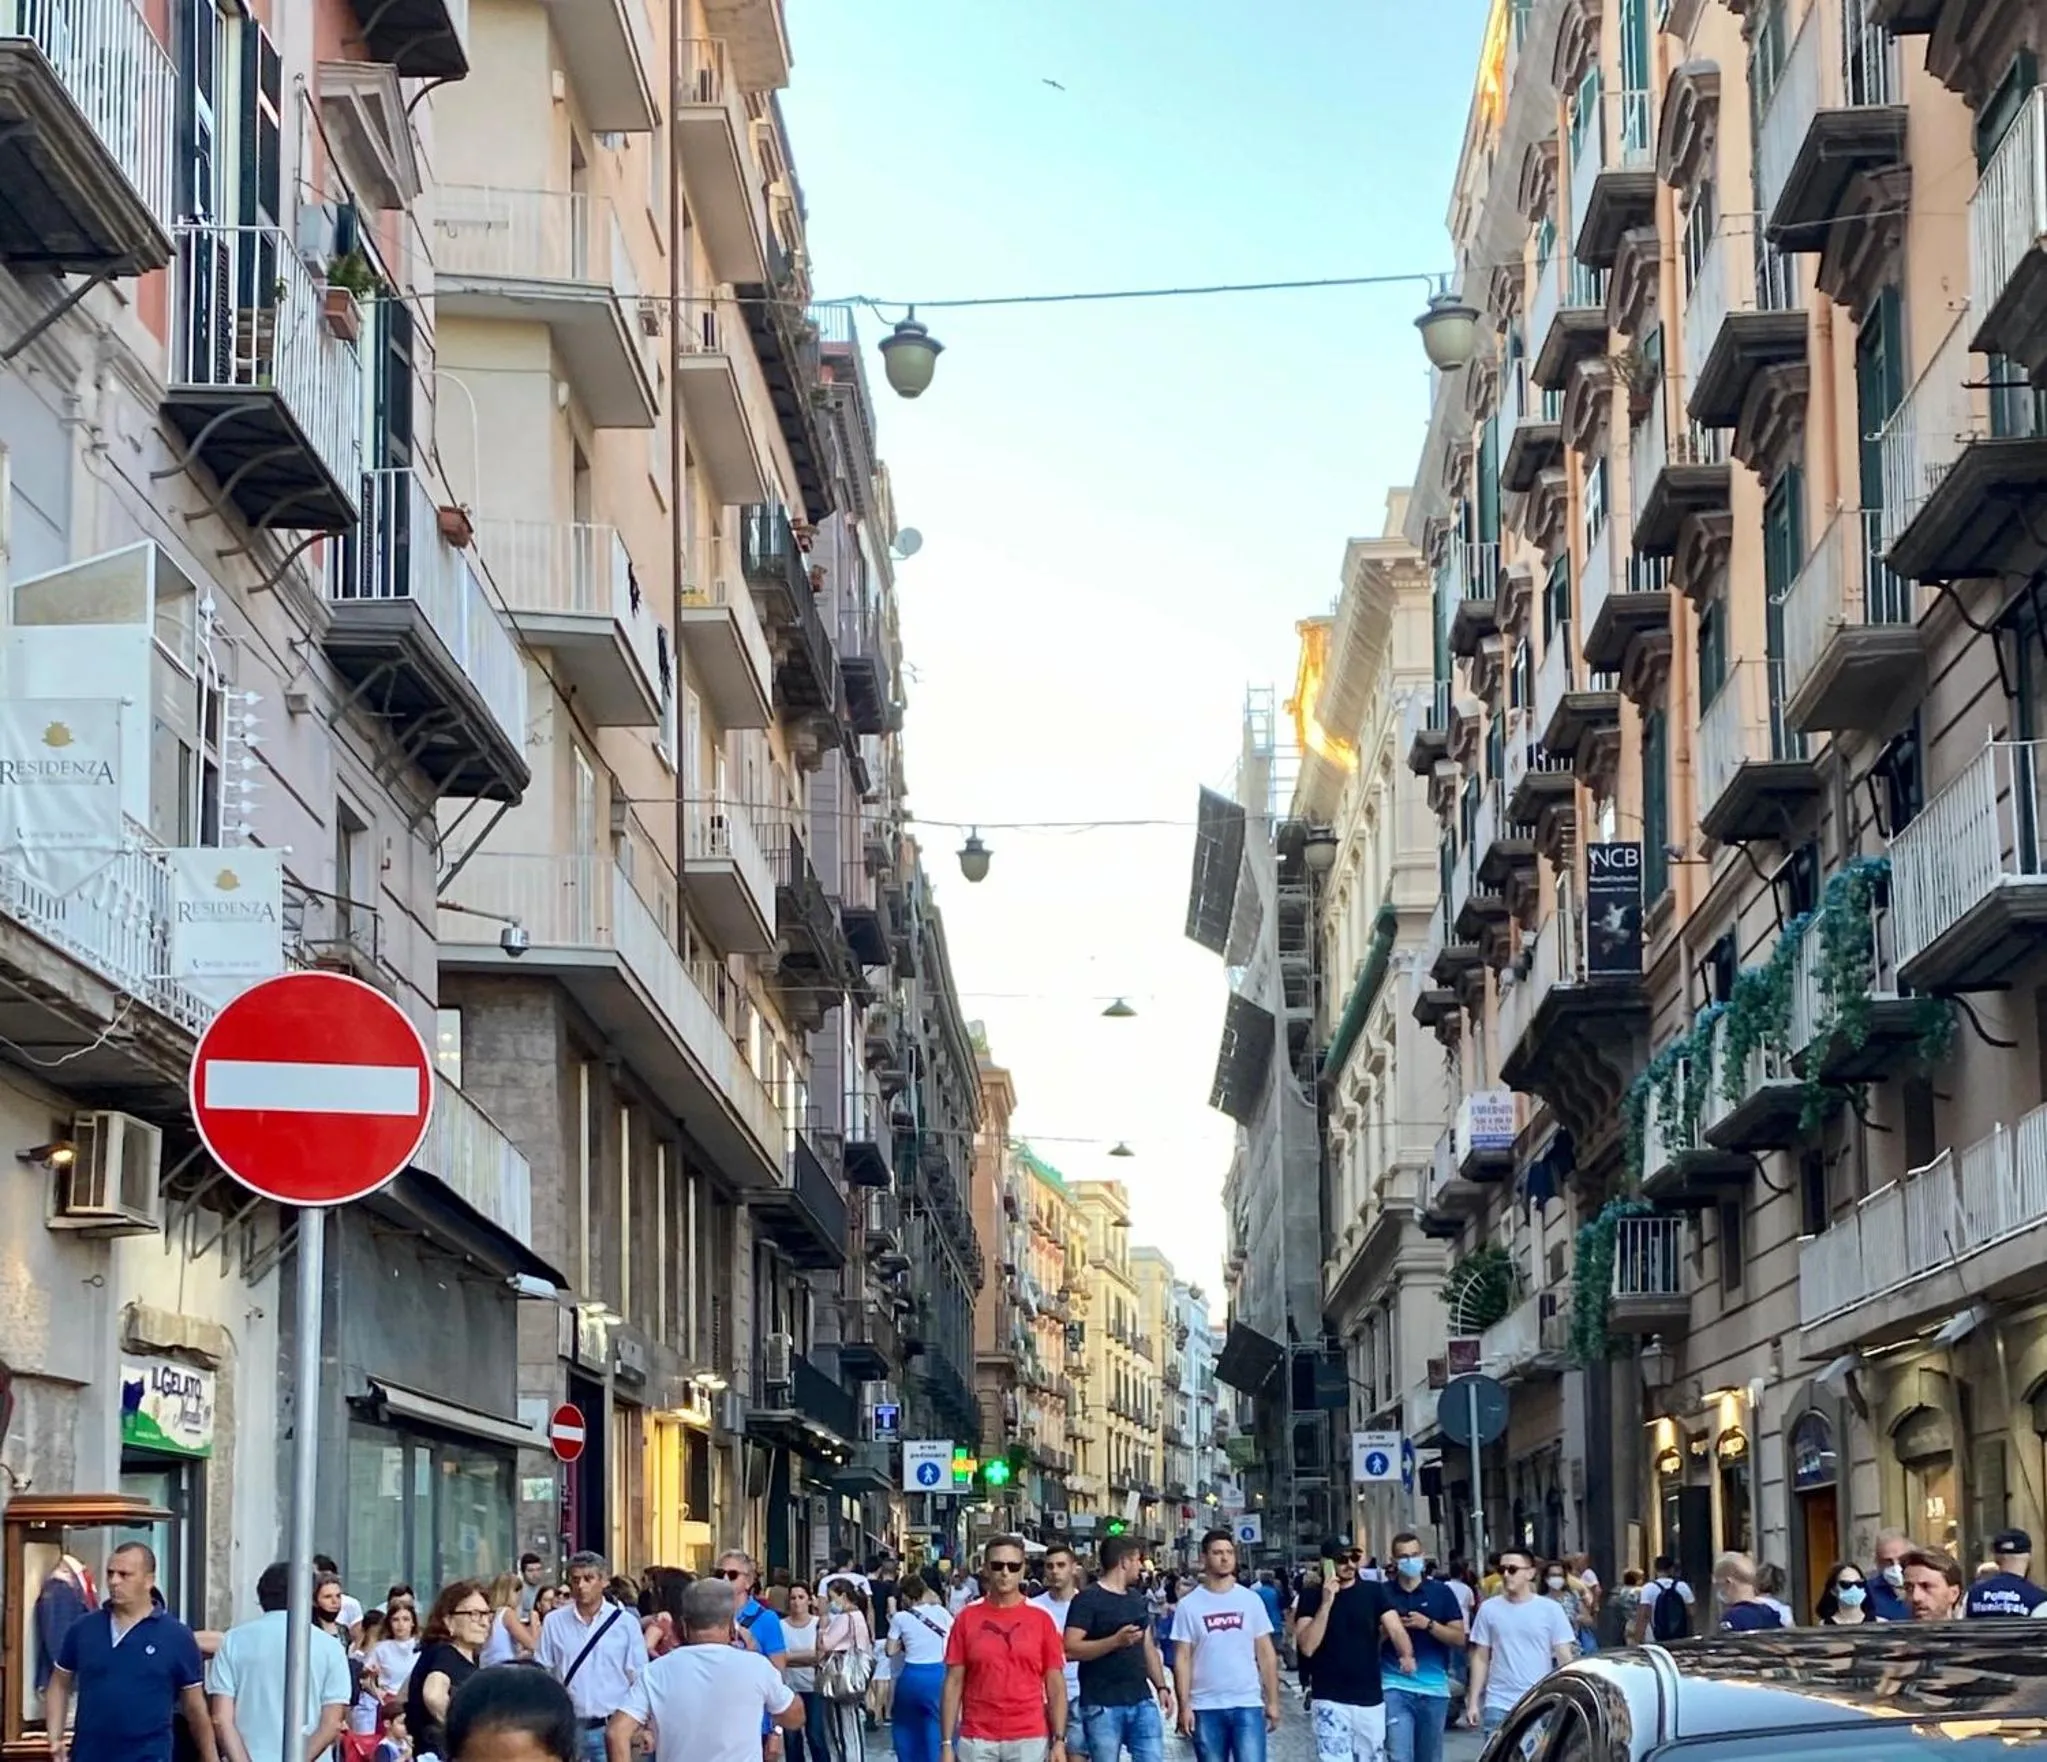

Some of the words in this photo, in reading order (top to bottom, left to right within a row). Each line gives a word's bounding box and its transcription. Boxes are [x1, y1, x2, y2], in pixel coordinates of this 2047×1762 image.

[0, 760, 115, 785] RESIDENZA
[1590, 847, 1640, 870] NCB
[177, 901, 276, 922] RESIDENZA
[161, 1366, 202, 1400] GELATO
[877, 1407, 897, 1428] T
